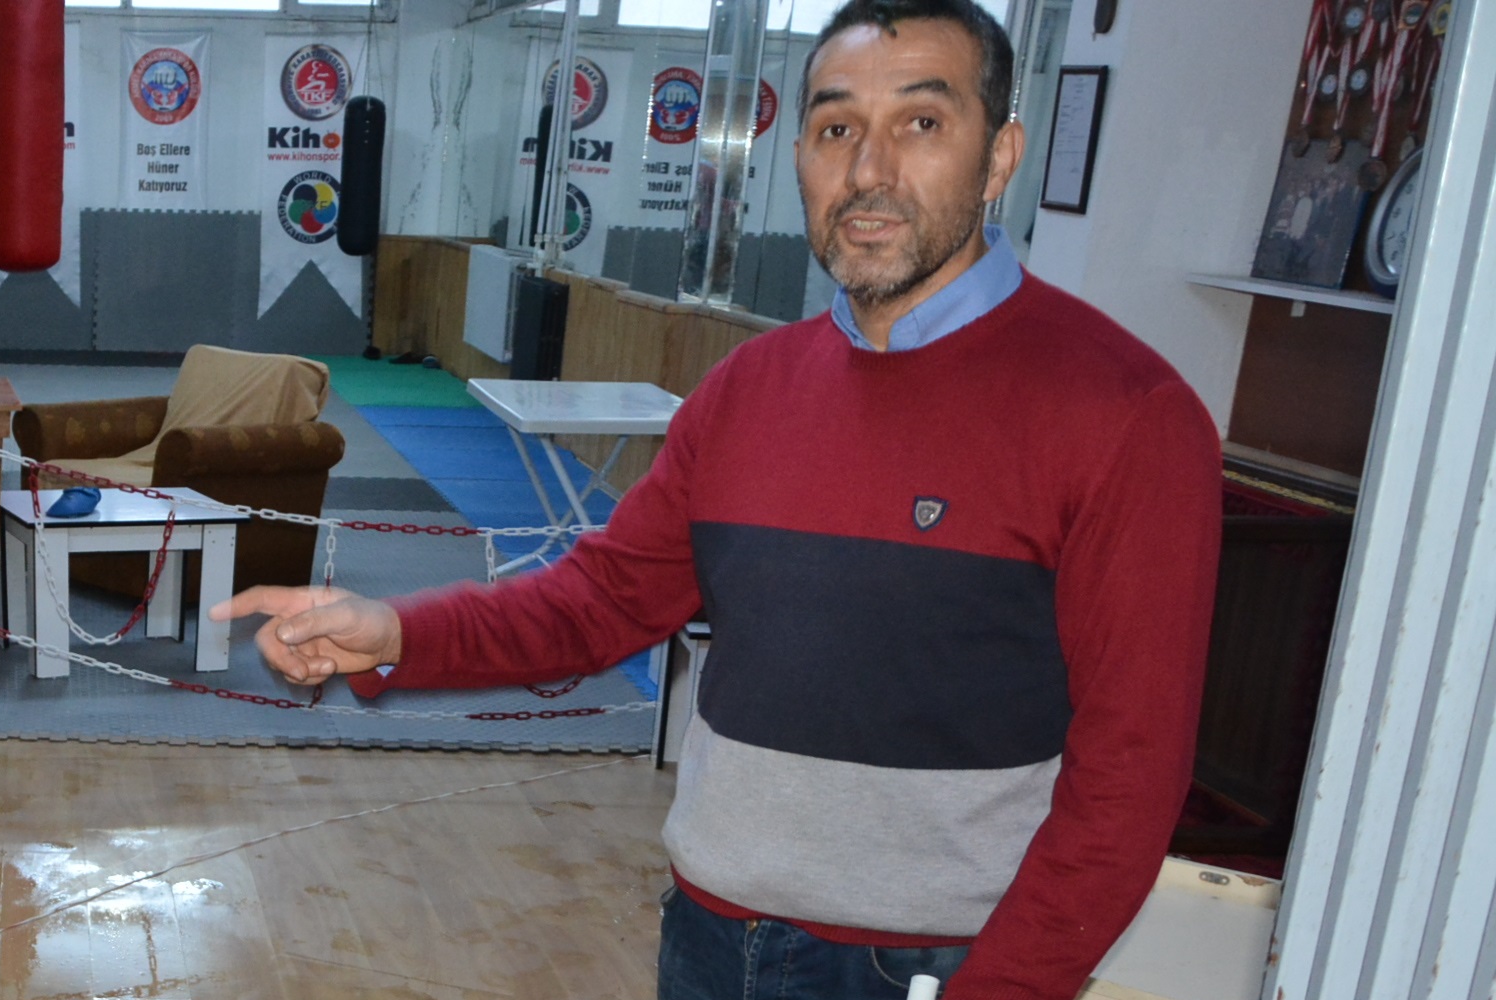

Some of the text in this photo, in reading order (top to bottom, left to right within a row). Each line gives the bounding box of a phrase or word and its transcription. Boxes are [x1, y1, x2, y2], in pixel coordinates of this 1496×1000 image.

[301, 91, 332, 103] TKF
[268, 125, 341, 149] Kiho
[136, 143, 191, 157] Boş Ellere
[147, 161, 179, 174] Hüner
[294, 171, 332, 184] WORLD
[138, 179, 188, 193] Katıyoruz
